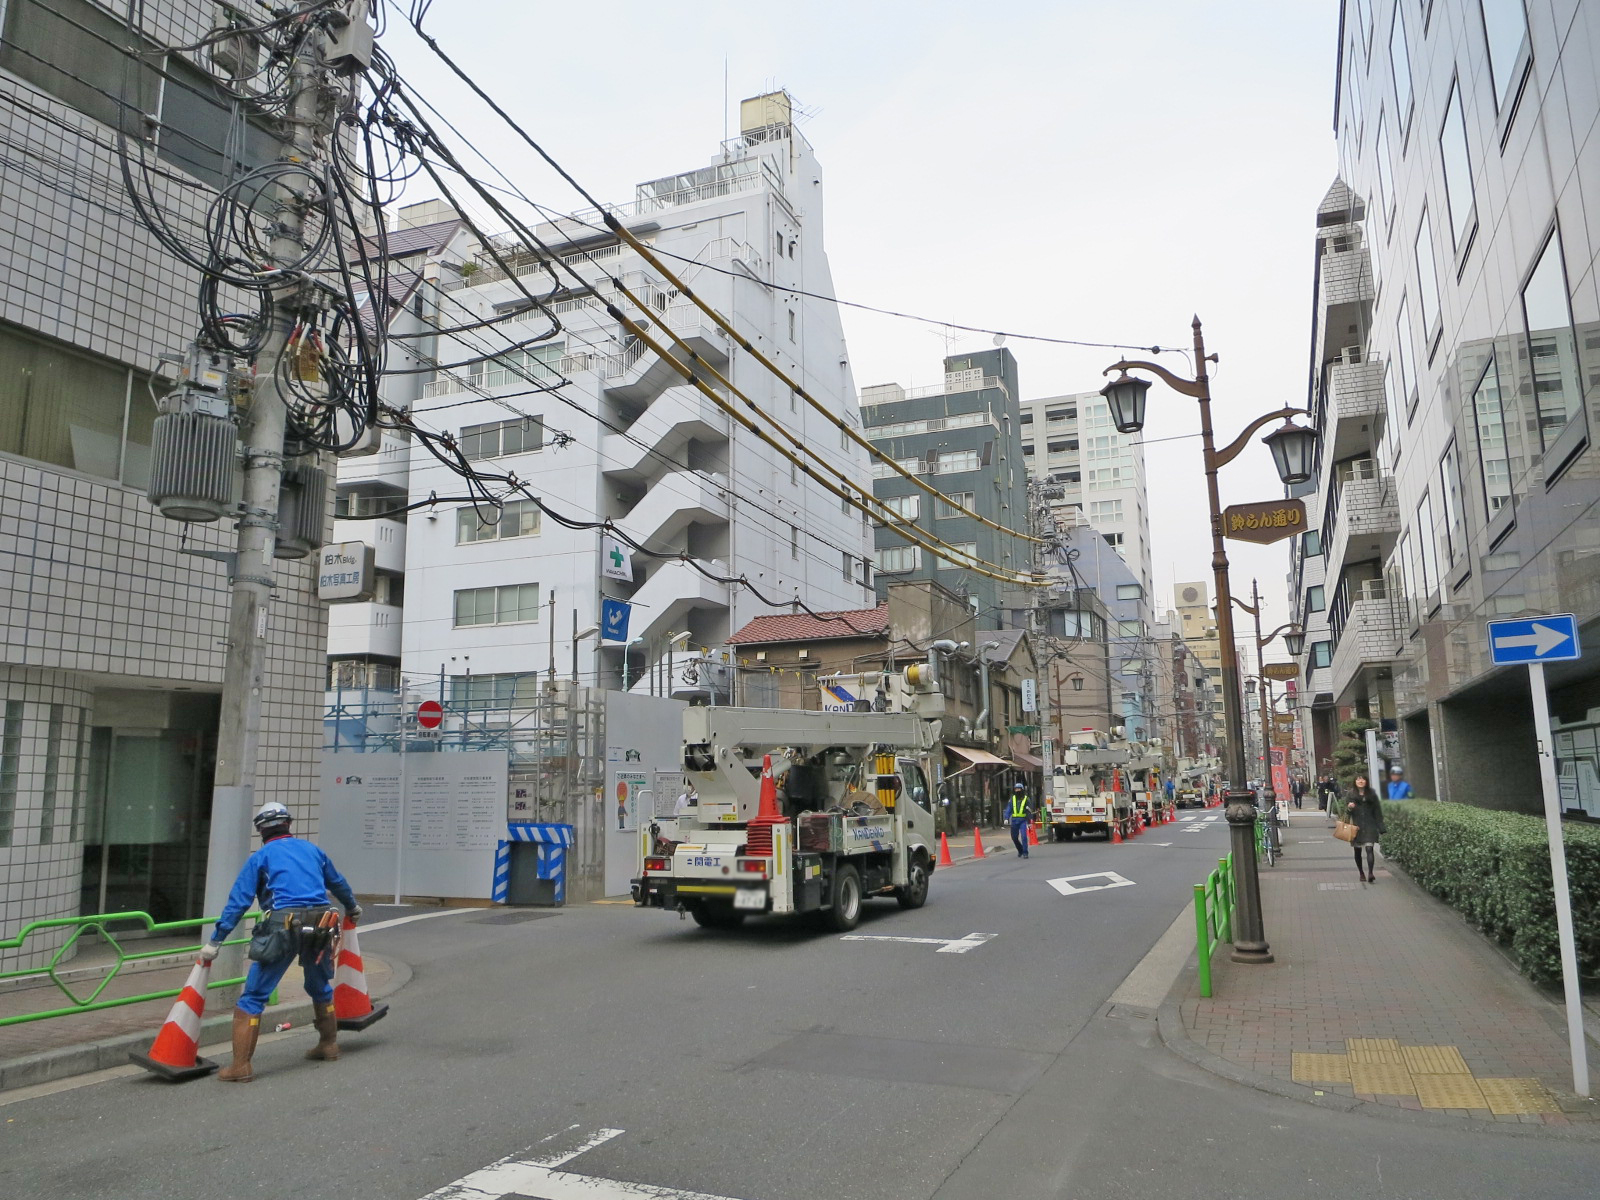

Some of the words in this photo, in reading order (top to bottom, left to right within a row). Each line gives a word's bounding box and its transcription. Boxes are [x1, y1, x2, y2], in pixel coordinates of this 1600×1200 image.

[1231, 508, 1301, 531] 鈴らん通り
[694, 856, 721, 866] 関電工
